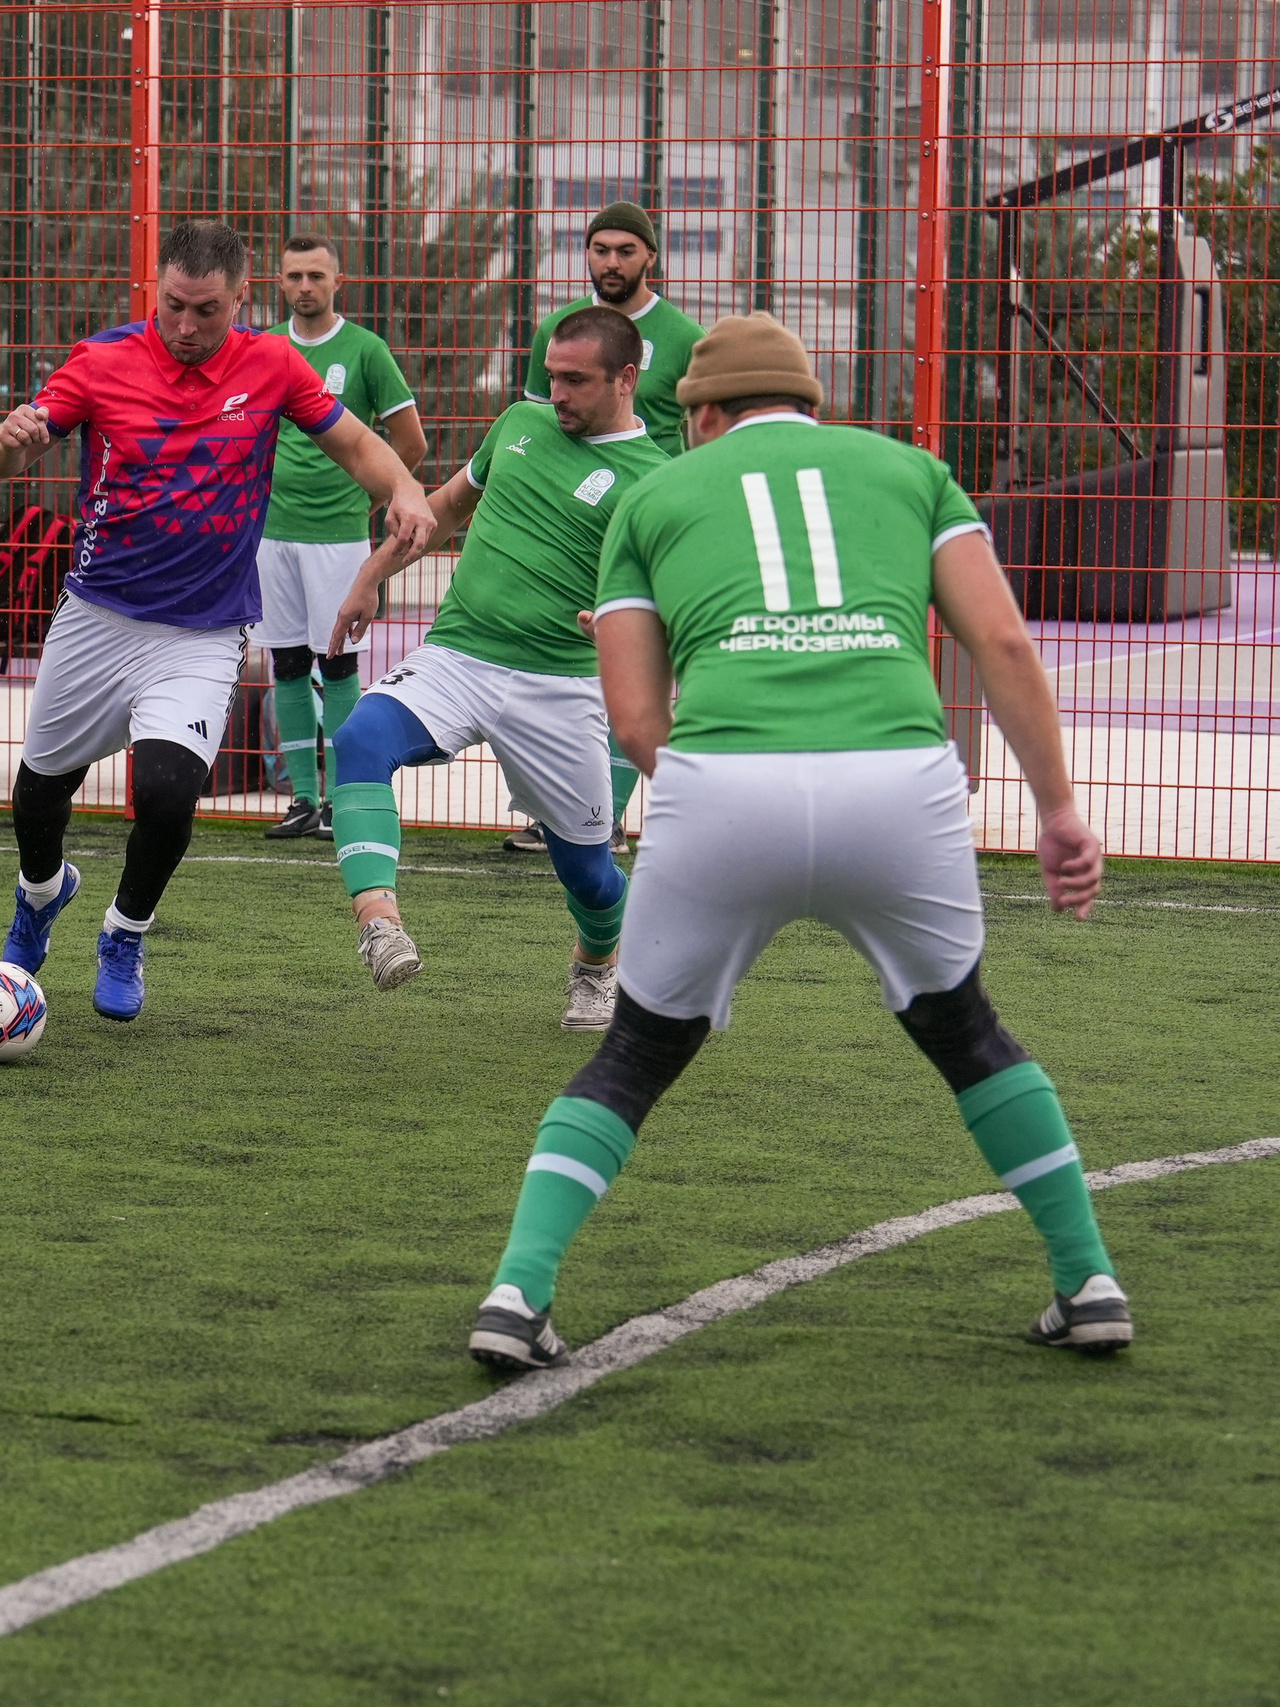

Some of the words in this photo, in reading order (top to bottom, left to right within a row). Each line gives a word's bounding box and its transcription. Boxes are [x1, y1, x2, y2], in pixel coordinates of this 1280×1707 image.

[741, 467, 843, 612] 11
[730, 613, 886, 635] АГРОНОМЫ
[719, 633, 901, 653] ЧЕРНОЗЕМЬЯ
